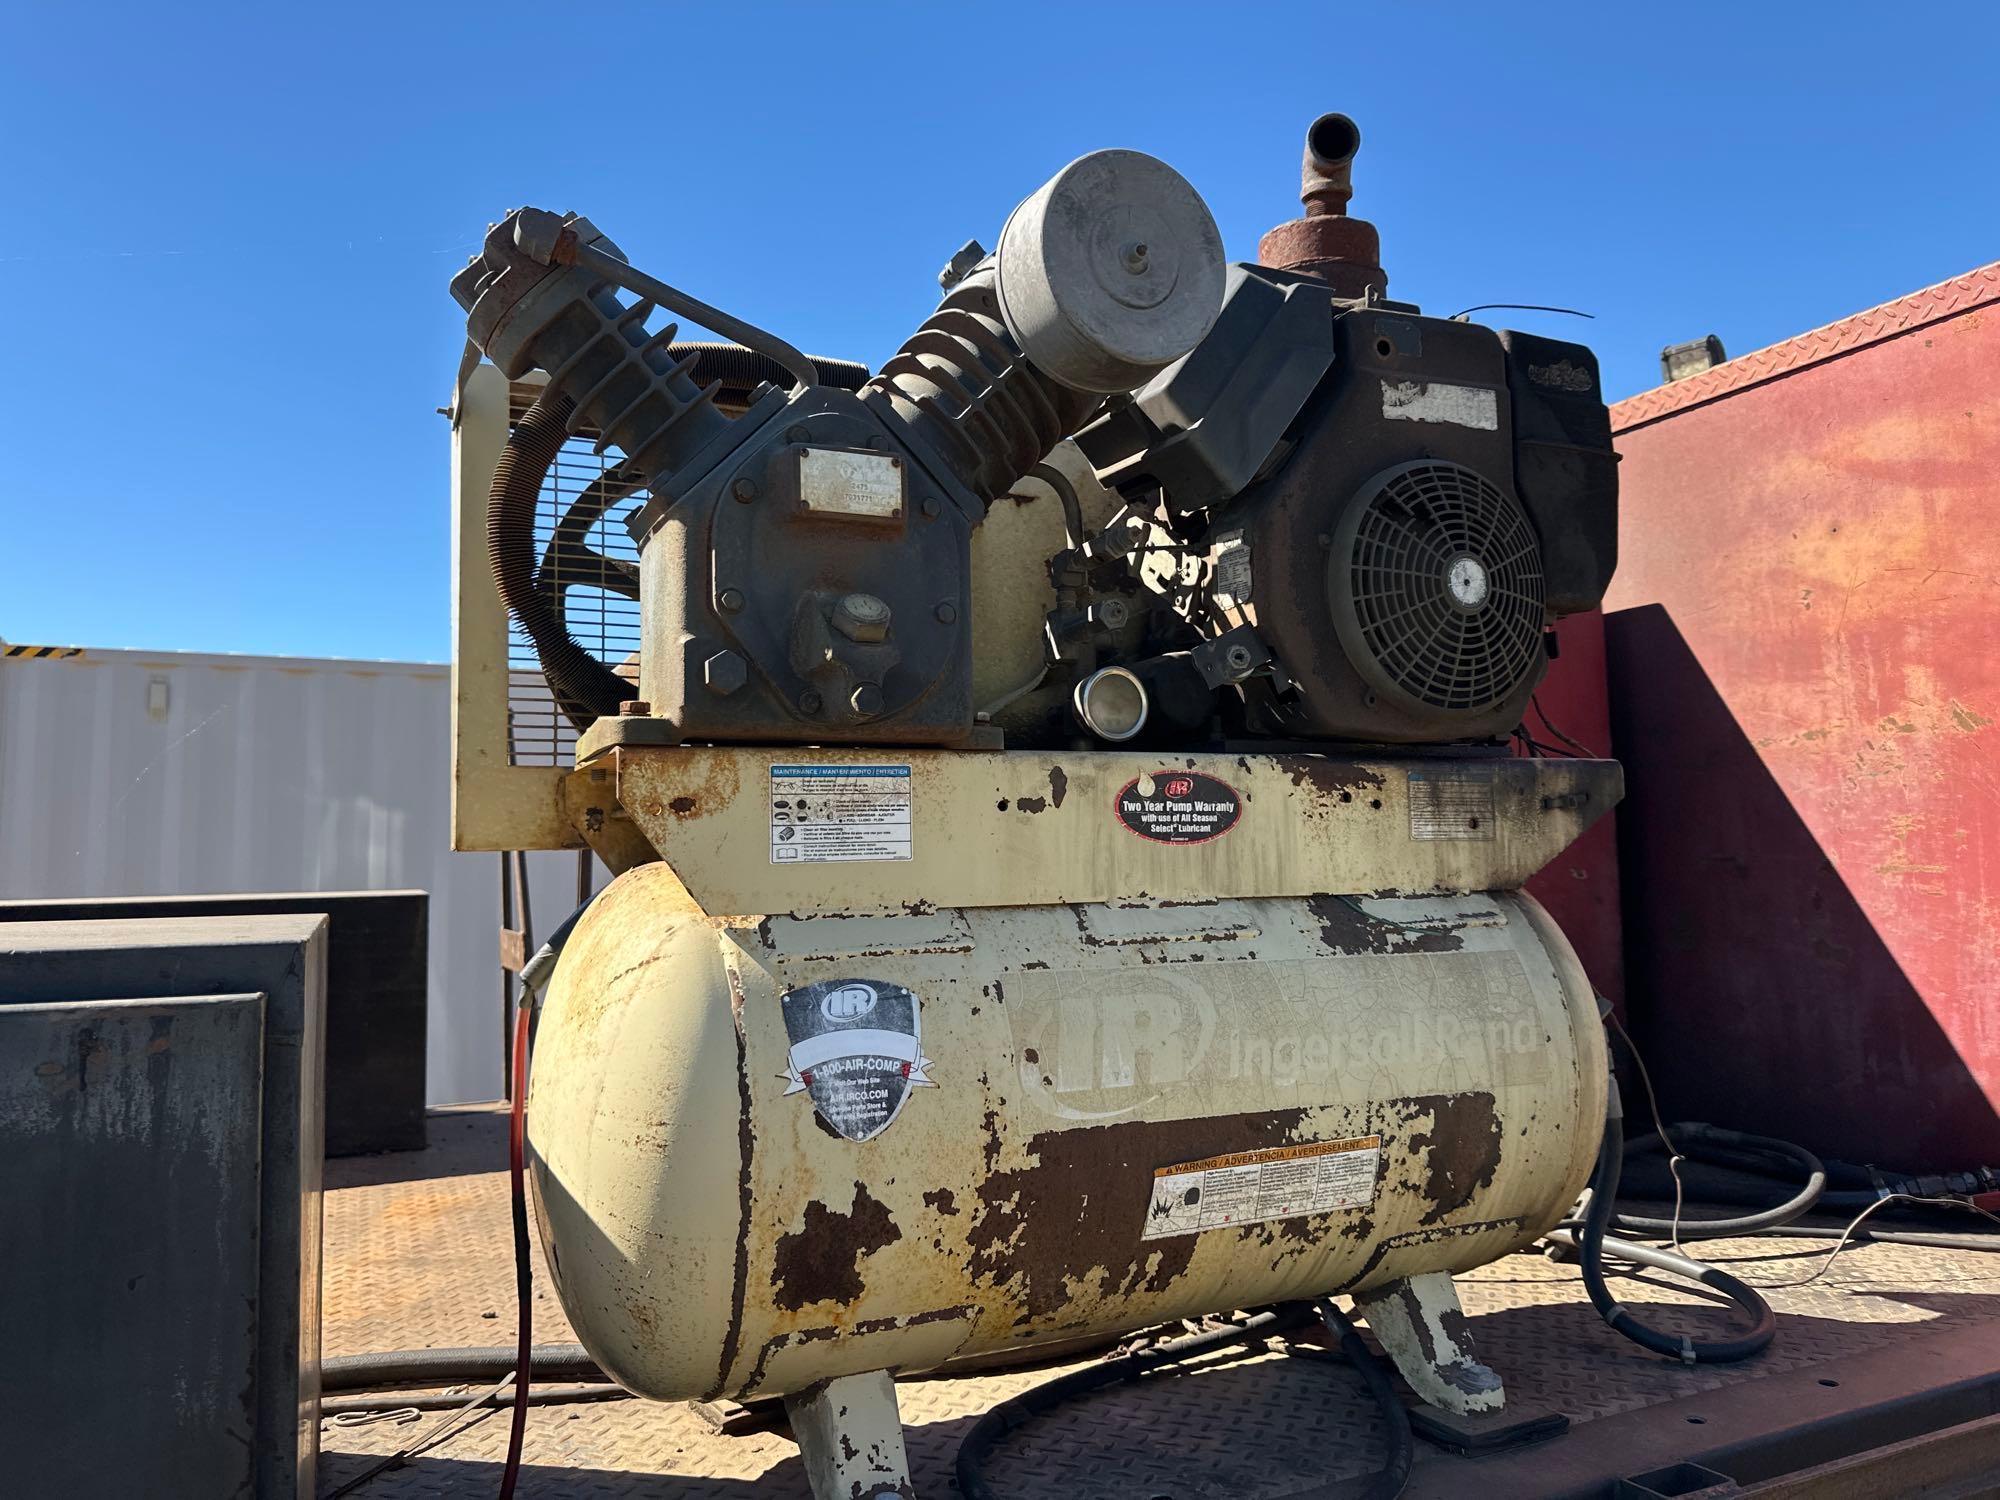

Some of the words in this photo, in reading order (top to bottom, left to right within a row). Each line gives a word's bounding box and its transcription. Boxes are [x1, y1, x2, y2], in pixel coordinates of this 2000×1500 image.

[1123, 801, 1141, 812] Two
[1143, 801, 1164, 812] Year
[1166, 801, 1192, 813] Pump
[1194, 801, 1235, 813] Warranty
[1141, 813, 1157, 822] with
[1172, 814, 1180, 822] of
[1181, 814, 1191, 822] All
[1192, 814, 1218, 822] Season
[1178, 824, 1211, 832] Lubricant
[831, 990, 868, 1016] IR
[812, 1058, 901, 1080] 1-800-AIR-COMP
[830, 1089, 889, 1103] AIR.IRCO.COM
[867, 1102, 881, 1110] Store
[856, 1110, 888, 1120] Registration
[1174, 1159, 1218, 1174] WARNING
[1224, 1151, 1285, 1167] ADVERTENCIA
[1292, 1140, 1361, 1158] AVERTISSEMENT
